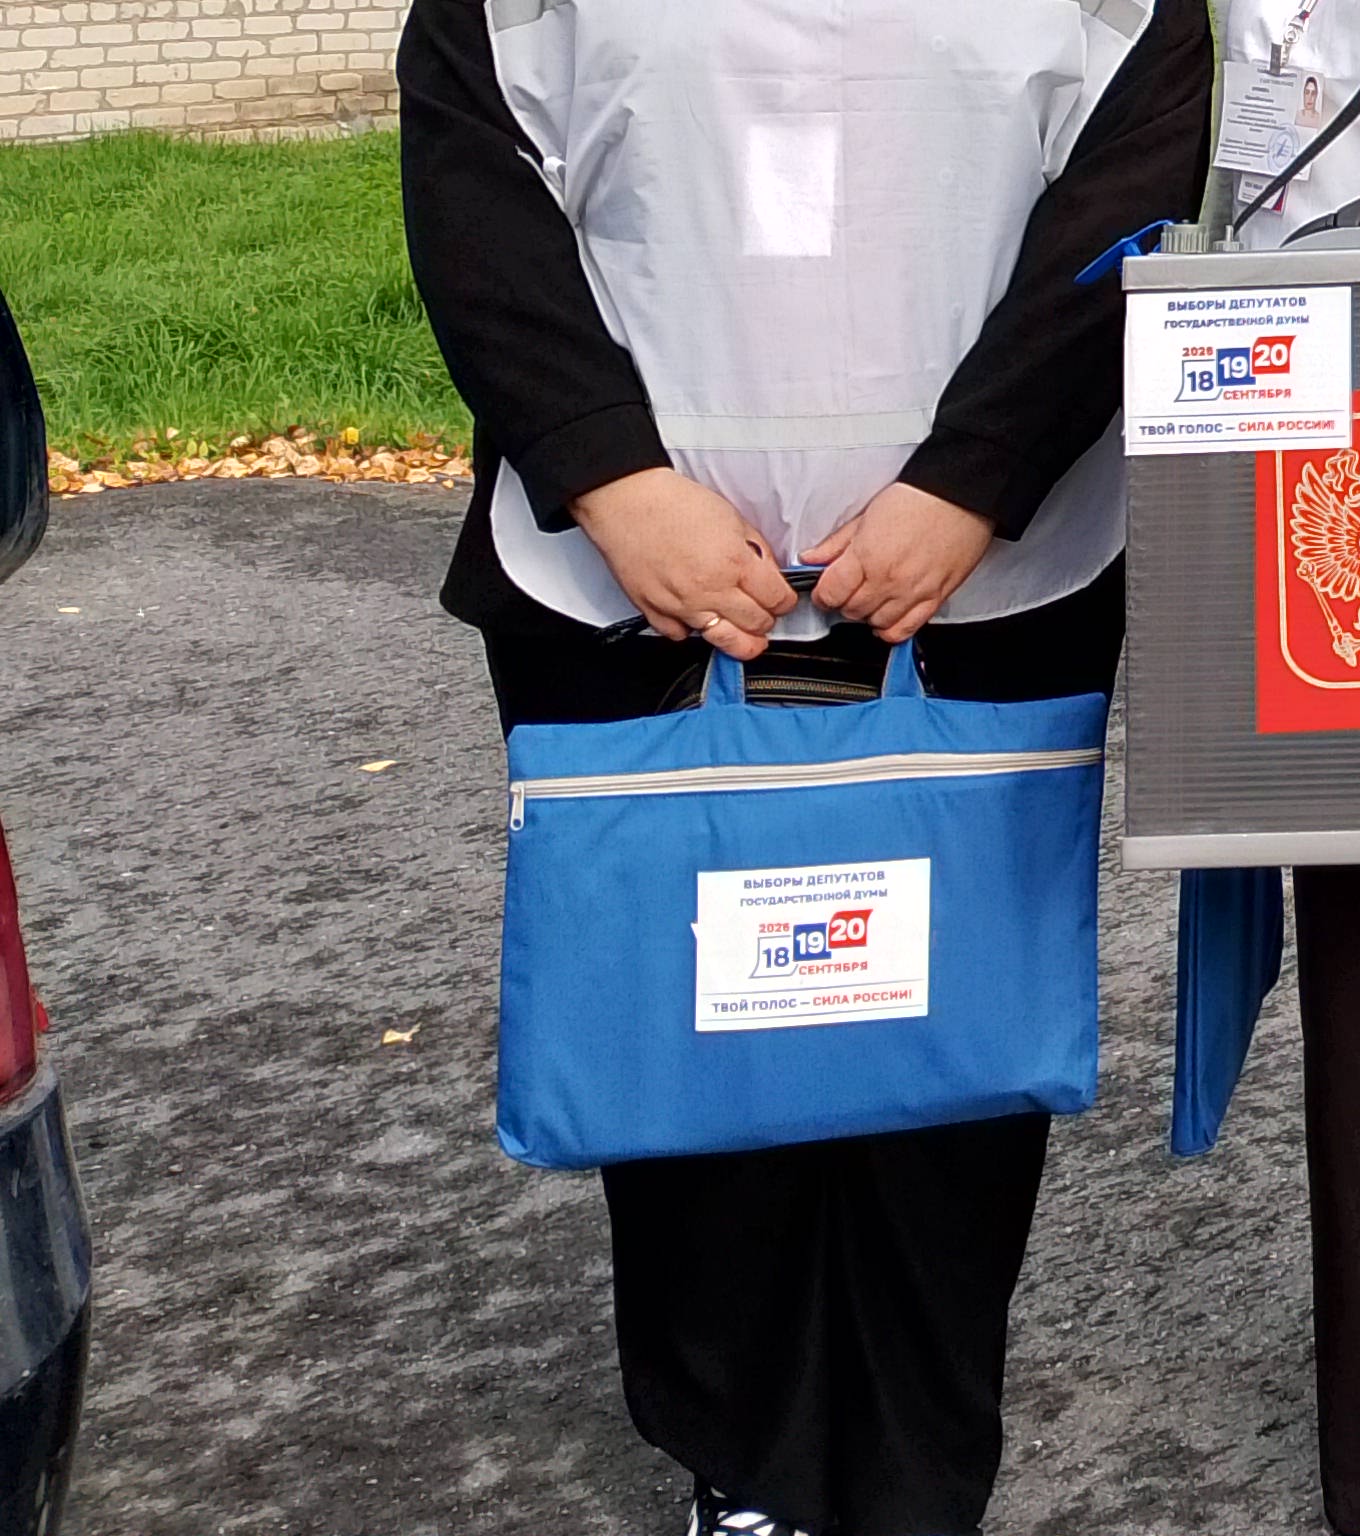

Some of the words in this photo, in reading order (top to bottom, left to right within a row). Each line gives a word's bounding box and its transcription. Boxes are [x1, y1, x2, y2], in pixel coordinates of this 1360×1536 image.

[1168, 300, 1226, 311] ВЫБОРЫ
[1229, 296, 1308, 310] ДЕПУТАТОВ
[1164, 315, 1274, 329] ГОСУДАРСТВЕННОЙ
[1276, 315, 1310, 326] ДУМЫ
[1187, 370, 1214, 392] 18
[1219, 356, 1249, 379] 19
[1254, 343, 1289, 367] 20
[1223, 388, 1292, 400] СЕНТЯБРЯ
[1139, 422, 1175, 435] ТВОЙ
[1178, 423, 1223, 434] ГОЛОС
[1238, 421, 1274, 432] СИЛА
[744, 877, 803, 889] ВЫБОРЫ
[806, 870, 886, 887] ДЕПУТАТОВ
[740, 889, 851, 907] ГОСУДАРСТВЕННОЙ
[853, 888, 888, 900] ДУМЫ
[758, 923, 790, 933] 2026
[762, 946, 789, 968] 18
[795, 931, 824, 955] 19
[830, 917, 865, 942] 20
[798, 961, 868, 975] СЕНТЯБРЯ
[712, 998, 748, 1013] ТВОЙ
[752, 997, 797, 1011] ГОЛОС
[812, 995, 849, 1007] СИЛА
[852, 989, 912, 1004] РОССИИ!
